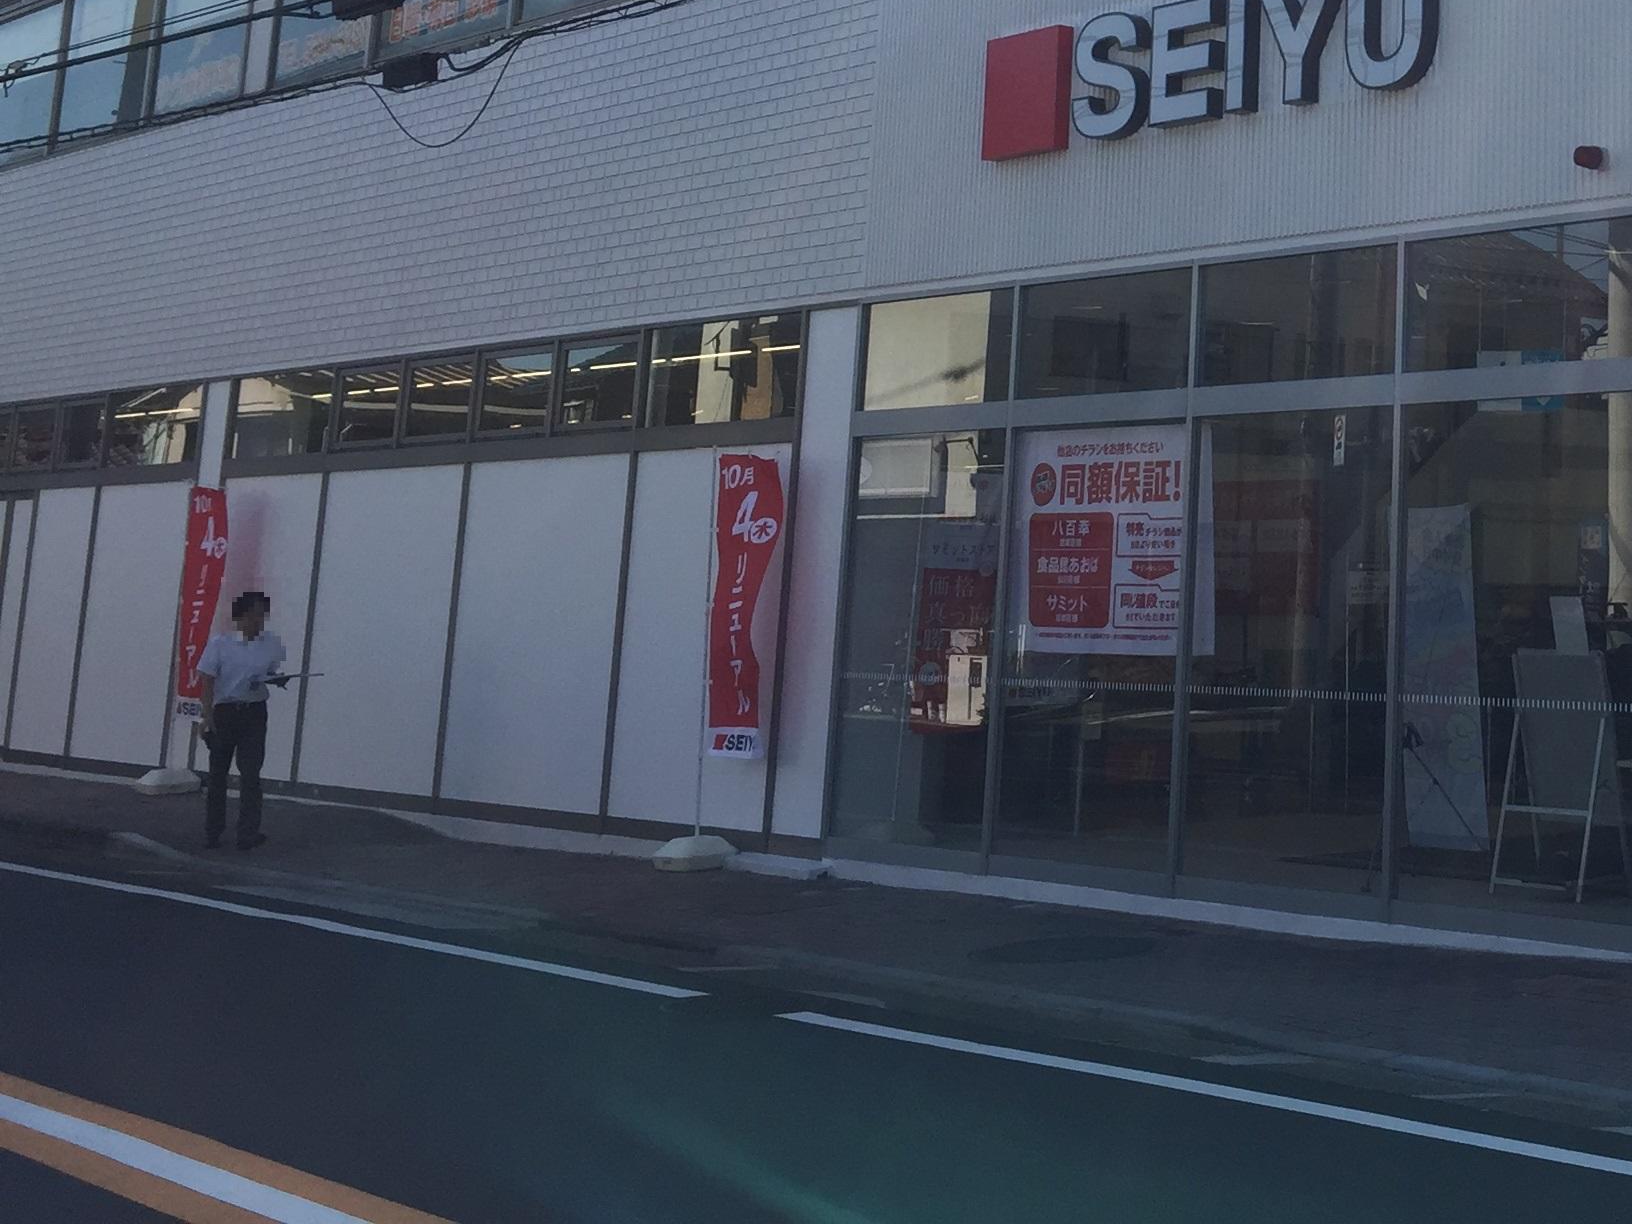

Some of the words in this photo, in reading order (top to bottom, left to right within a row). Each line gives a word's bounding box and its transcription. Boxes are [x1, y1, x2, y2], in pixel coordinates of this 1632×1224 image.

[721, 464, 754, 489] 10月
[928, 575, 975, 597] 価格
[1046, 594, 1089, 612] サミット
[728, 552, 750, 716] リニューアル
